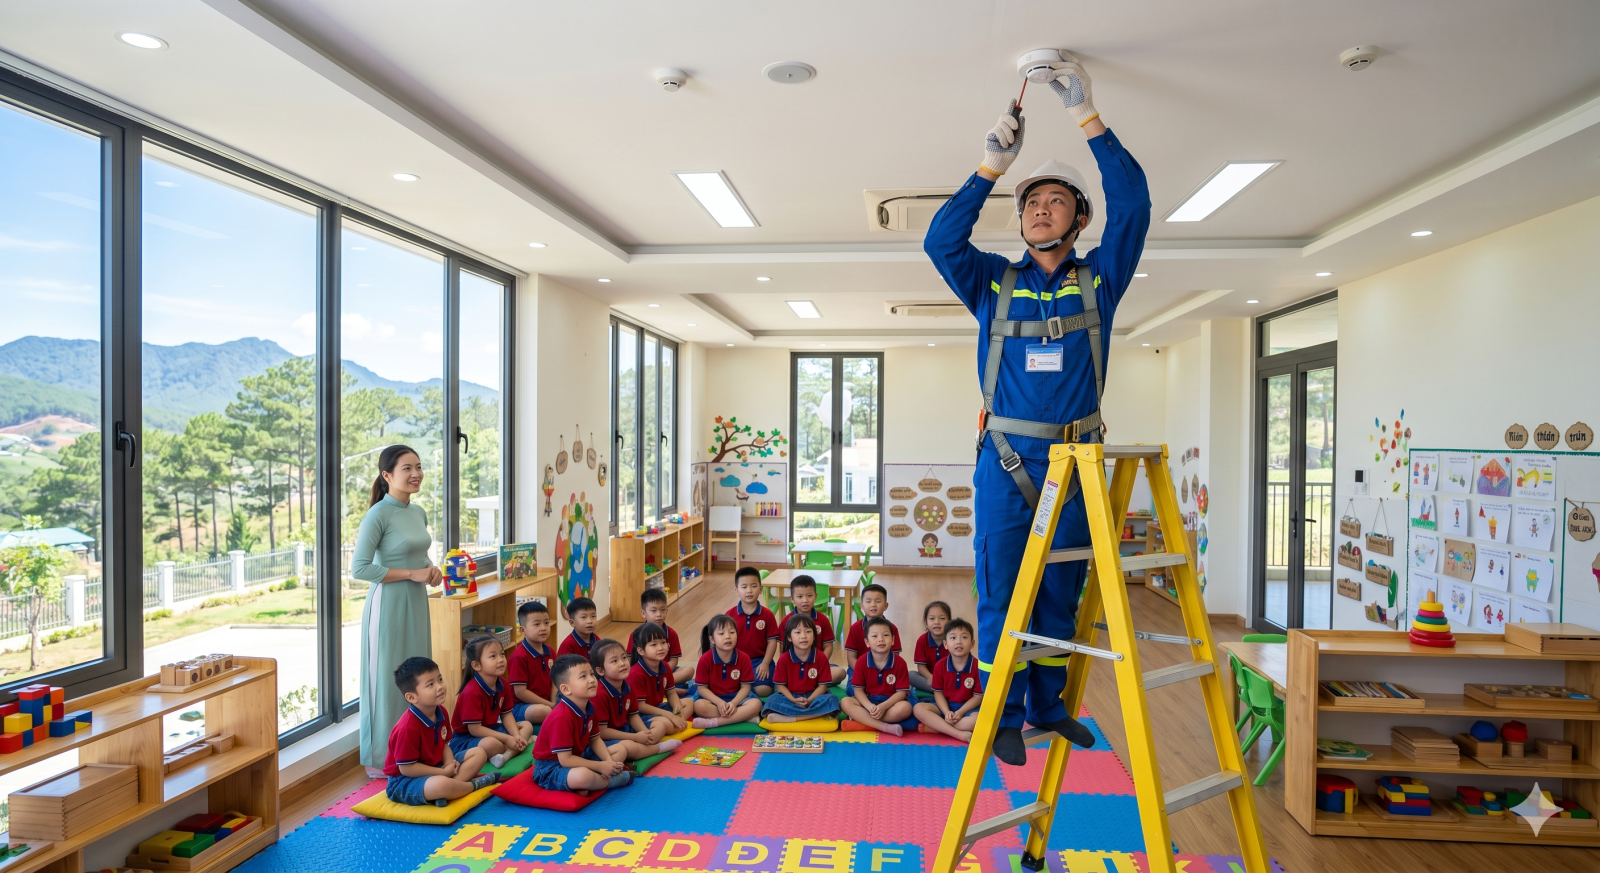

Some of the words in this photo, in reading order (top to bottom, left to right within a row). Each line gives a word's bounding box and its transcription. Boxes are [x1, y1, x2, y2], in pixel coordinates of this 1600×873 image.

[450, 830, 495, 853] A
[520, 833, 568, 856] B
[592, 836, 634, 859] C
[657, 838, 701, 862] D
[726, 841, 769, 865] Đ
[798, 845, 837, 869] E
[870, 848, 905, 872] F
